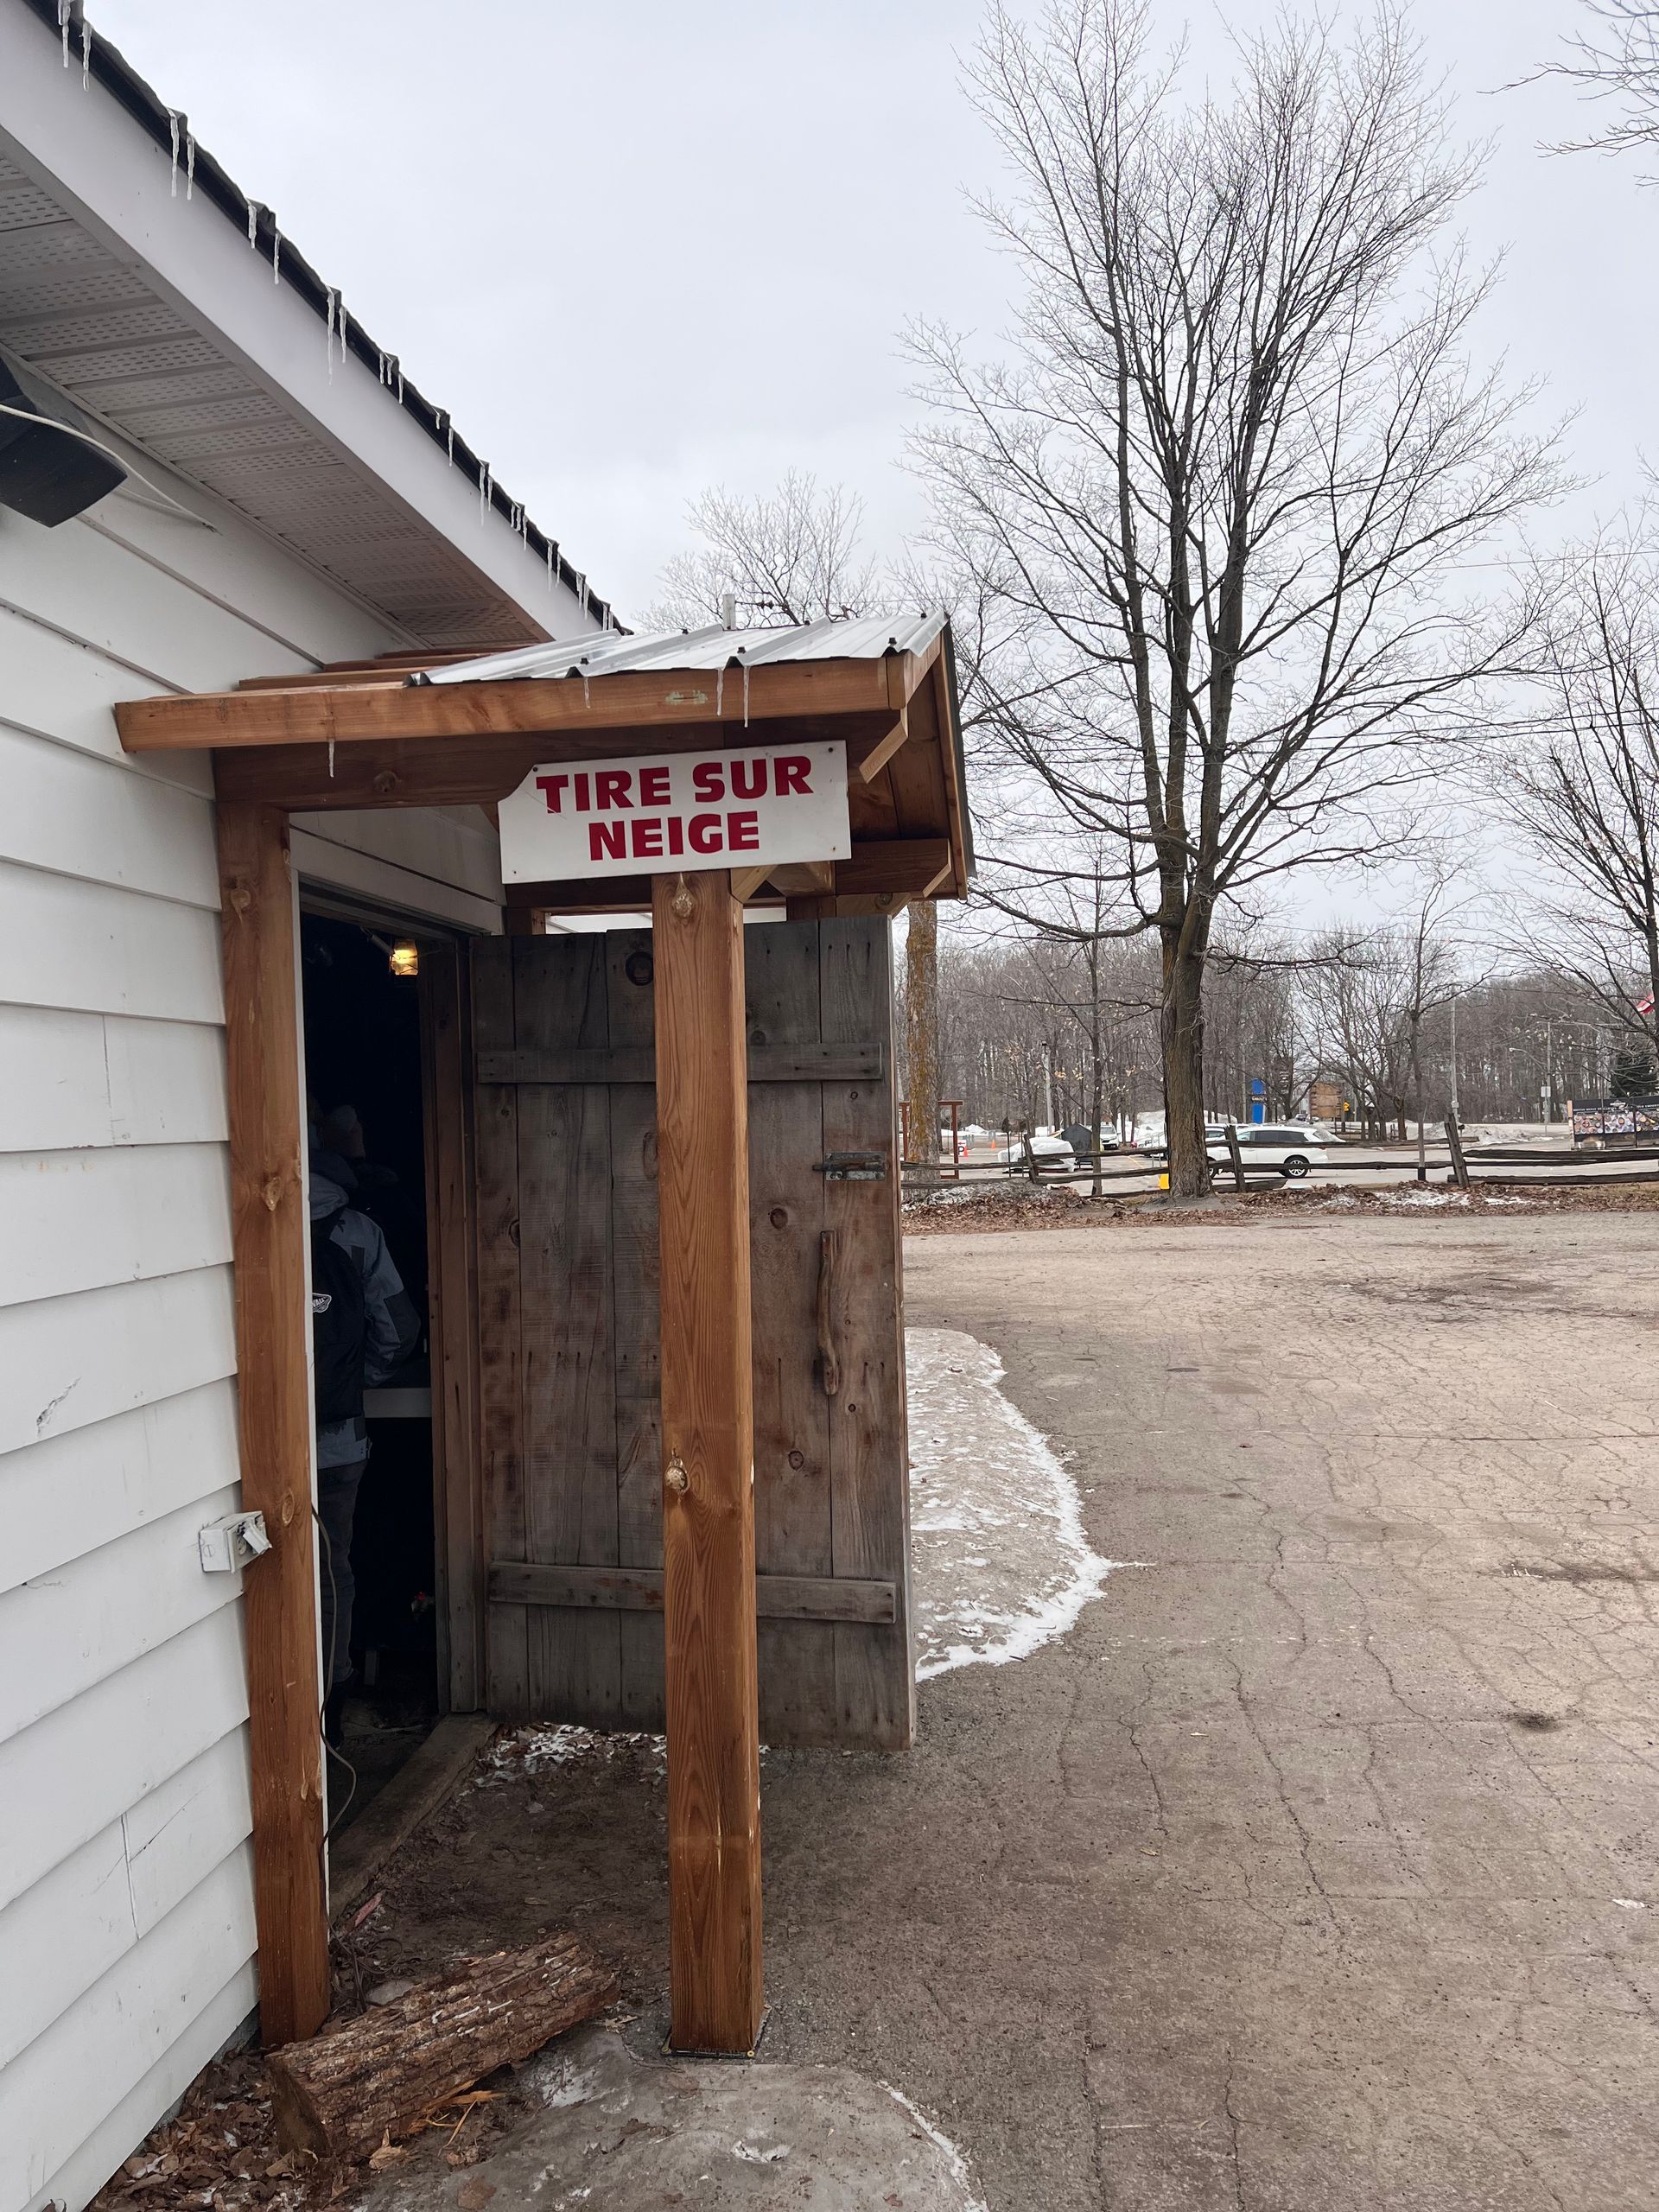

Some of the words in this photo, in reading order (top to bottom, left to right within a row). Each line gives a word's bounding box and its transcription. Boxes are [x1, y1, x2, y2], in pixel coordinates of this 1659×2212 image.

[536, 767, 671, 814] TIRE
[692, 755, 814, 804] SUR
[588, 810, 760, 861] NEIGE
